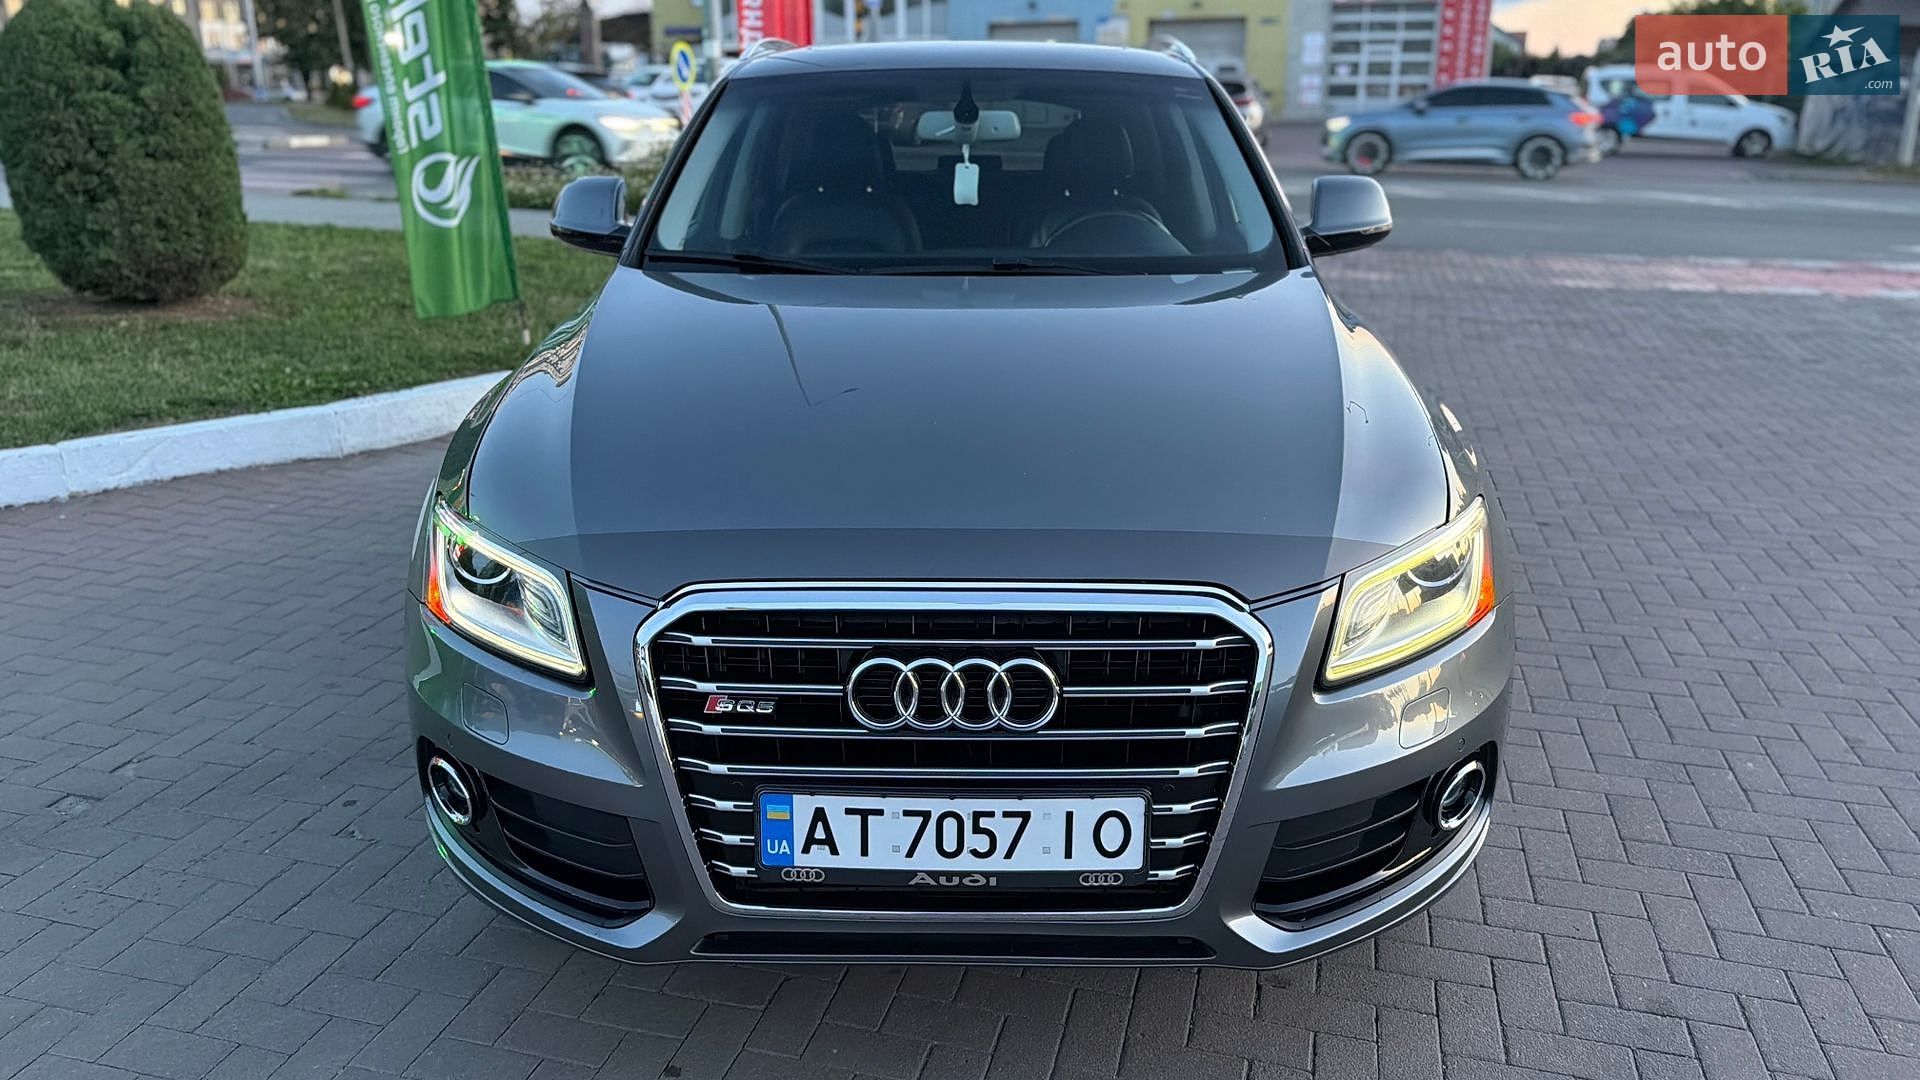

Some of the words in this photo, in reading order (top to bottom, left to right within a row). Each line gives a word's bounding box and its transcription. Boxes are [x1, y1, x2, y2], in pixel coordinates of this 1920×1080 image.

[713, 698, 776, 713] SQ5
[800, 806, 885, 858] AT
[902, 808, 1032, 860] 7057
[1063, 809, 1133, 861] IO
[766, 839, 791, 855] UA
[907, 872, 997, 886] Audi
